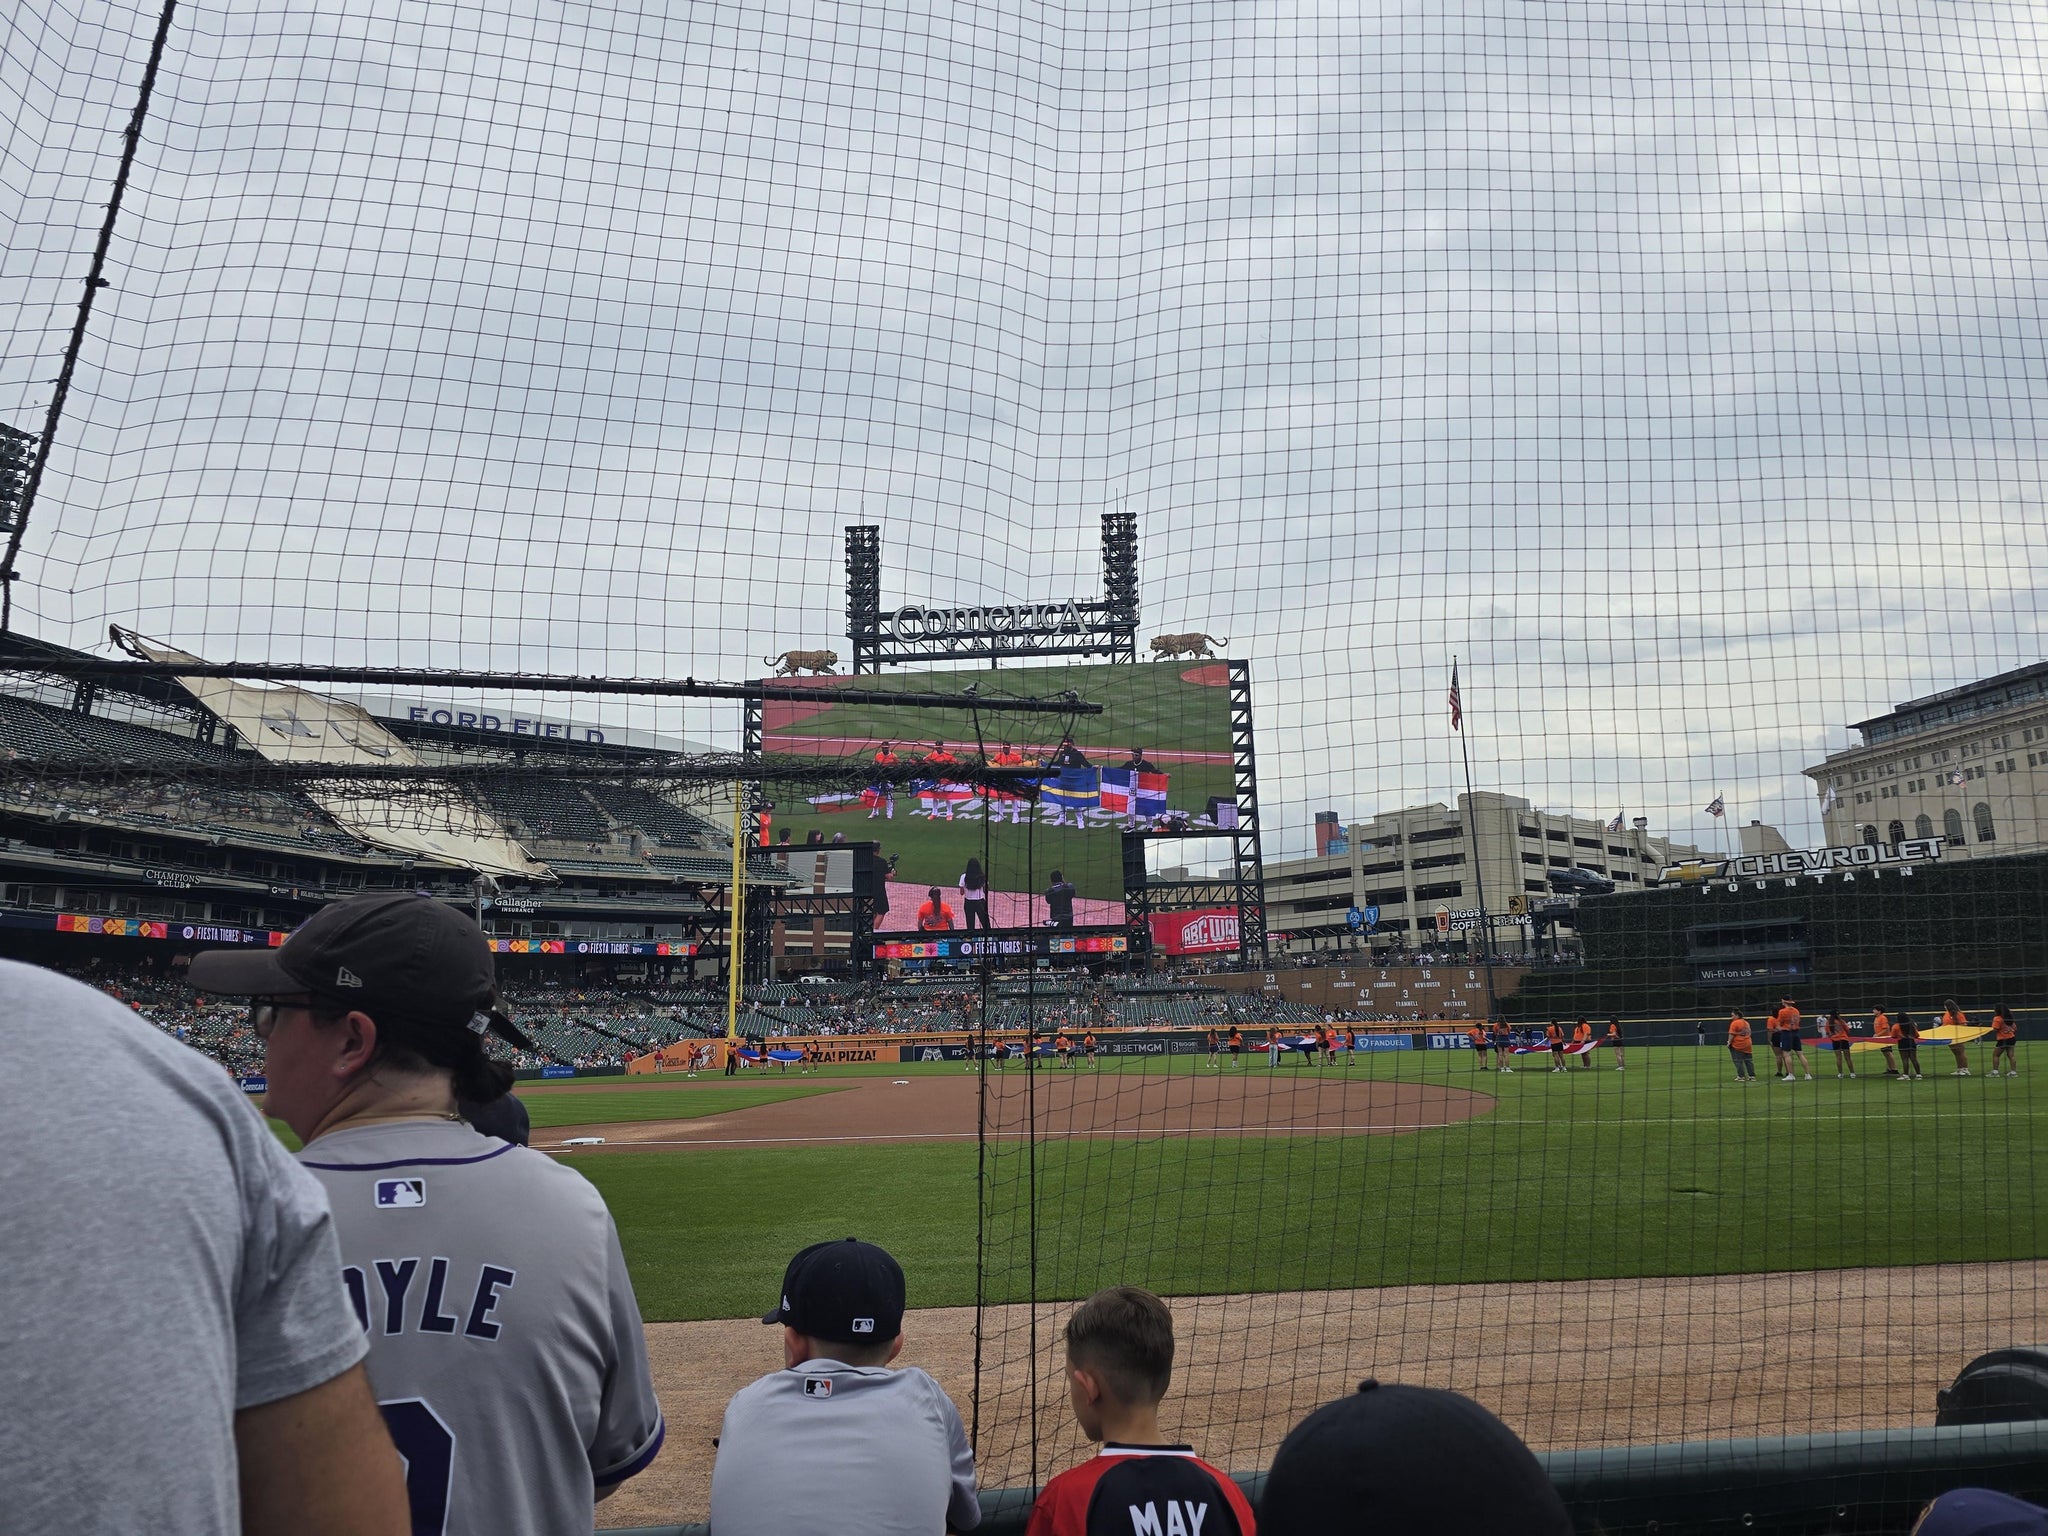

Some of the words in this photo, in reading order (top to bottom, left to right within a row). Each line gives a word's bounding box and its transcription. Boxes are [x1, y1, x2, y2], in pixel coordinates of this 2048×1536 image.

[946, 633, 1037, 651] PARK
[408, 706, 501, 733] FORD
[513, 718, 605, 744] FIELD
[1735, 836, 1946, 877] CHEVROLET
[145, 869, 201, 885] CHAMPIONS
[1702, 866, 1914, 896] FOUNTAIN
[163, 879, 185, 889] CLUB
[494, 897, 543, 909] Gallagher
[1450, 907, 1487, 919] BIGGB
[1184, 919, 1208, 945] ABC
[1265, 974, 1275, 983] 23
[1340, 970, 1346, 980] 5
[1381, 970, 1387, 979] 2
[1422, 970, 1431, 979] 16
[1469, 970, 1475, 979] 6
[1701, 969, 1726, 979] Wi-Fi
[1727, 970, 1739, 978] on
[1359, 989, 1370, 998] 47
[1402, 989, 1409, 998] 3
[1370, 1038, 1405, 1048] FANDUEL
[1432, 1033, 1471, 1049] DTE
[1121, 1043, 1162, 1053] BETMGM
[838, 1050, 877, 1062] PIZZA!
[1128, 1500, 1208, 1536] MAY
